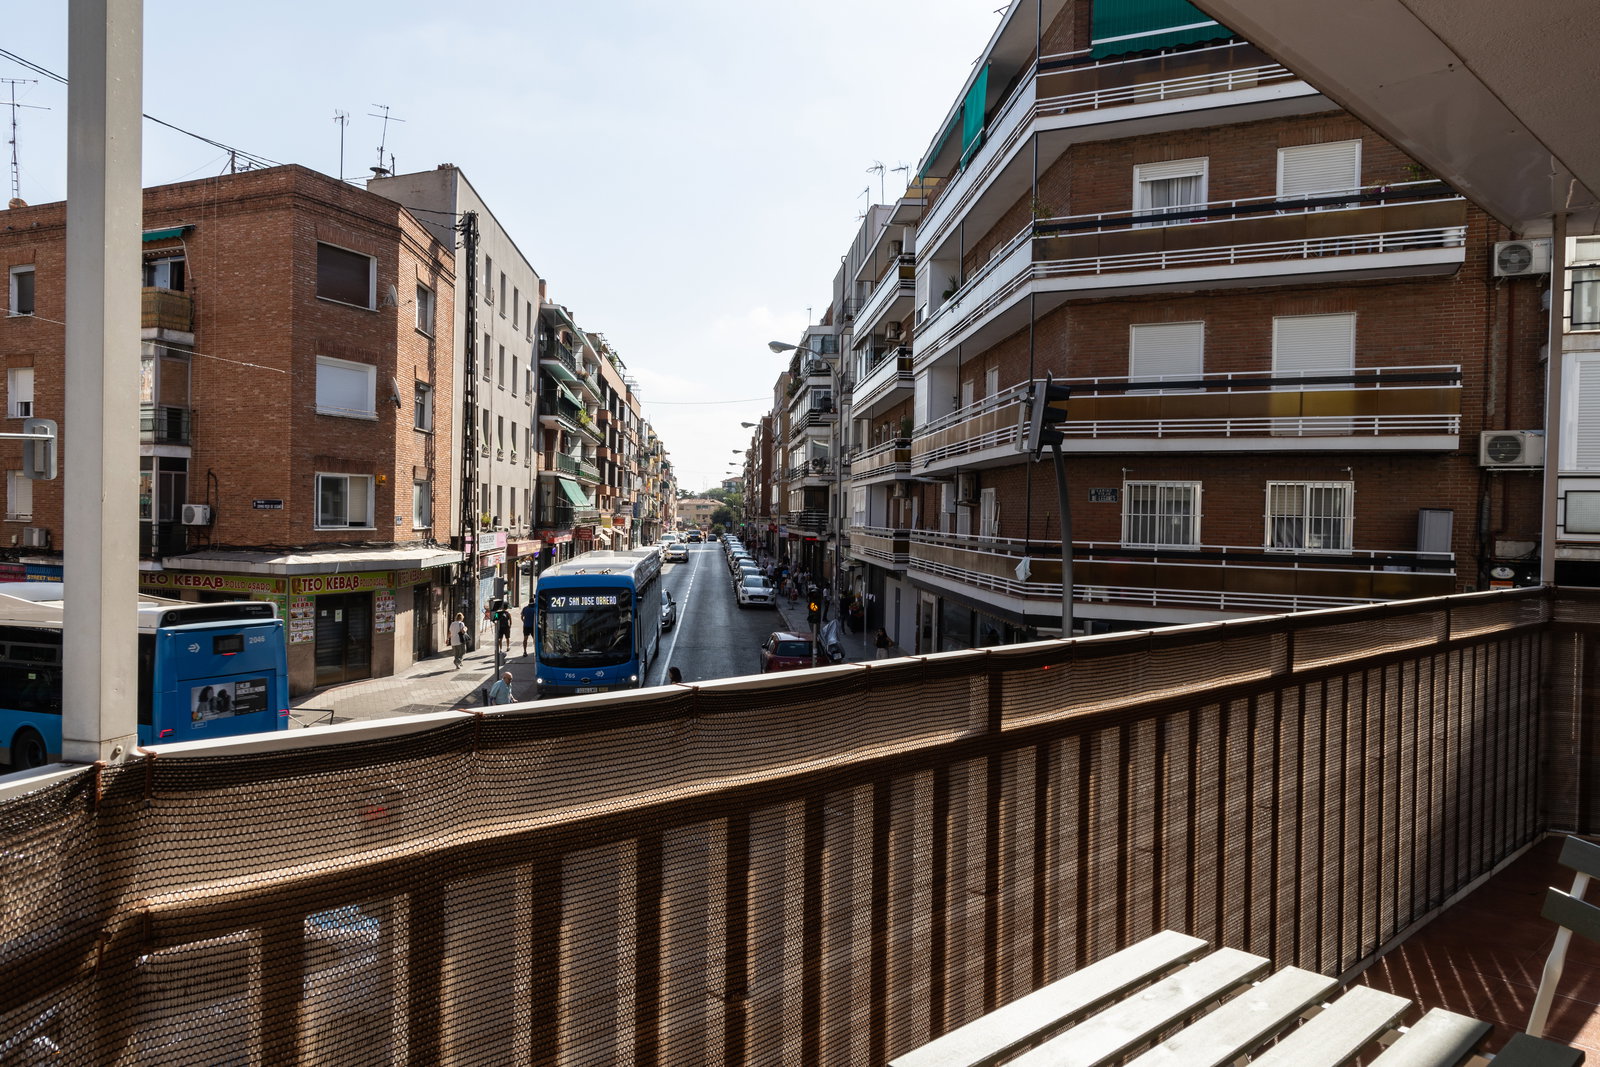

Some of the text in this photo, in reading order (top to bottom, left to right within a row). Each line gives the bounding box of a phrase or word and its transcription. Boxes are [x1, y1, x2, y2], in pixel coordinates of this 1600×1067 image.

[141, 573, 168, 585] TEO
[173, 574, 224, 589] KEBAB
[302, 578, 323, 592] TEO
[326, 575, 360, 590] KEBAB
[551, 595, 617, 608] 247 SAN JOSE OBRERO
